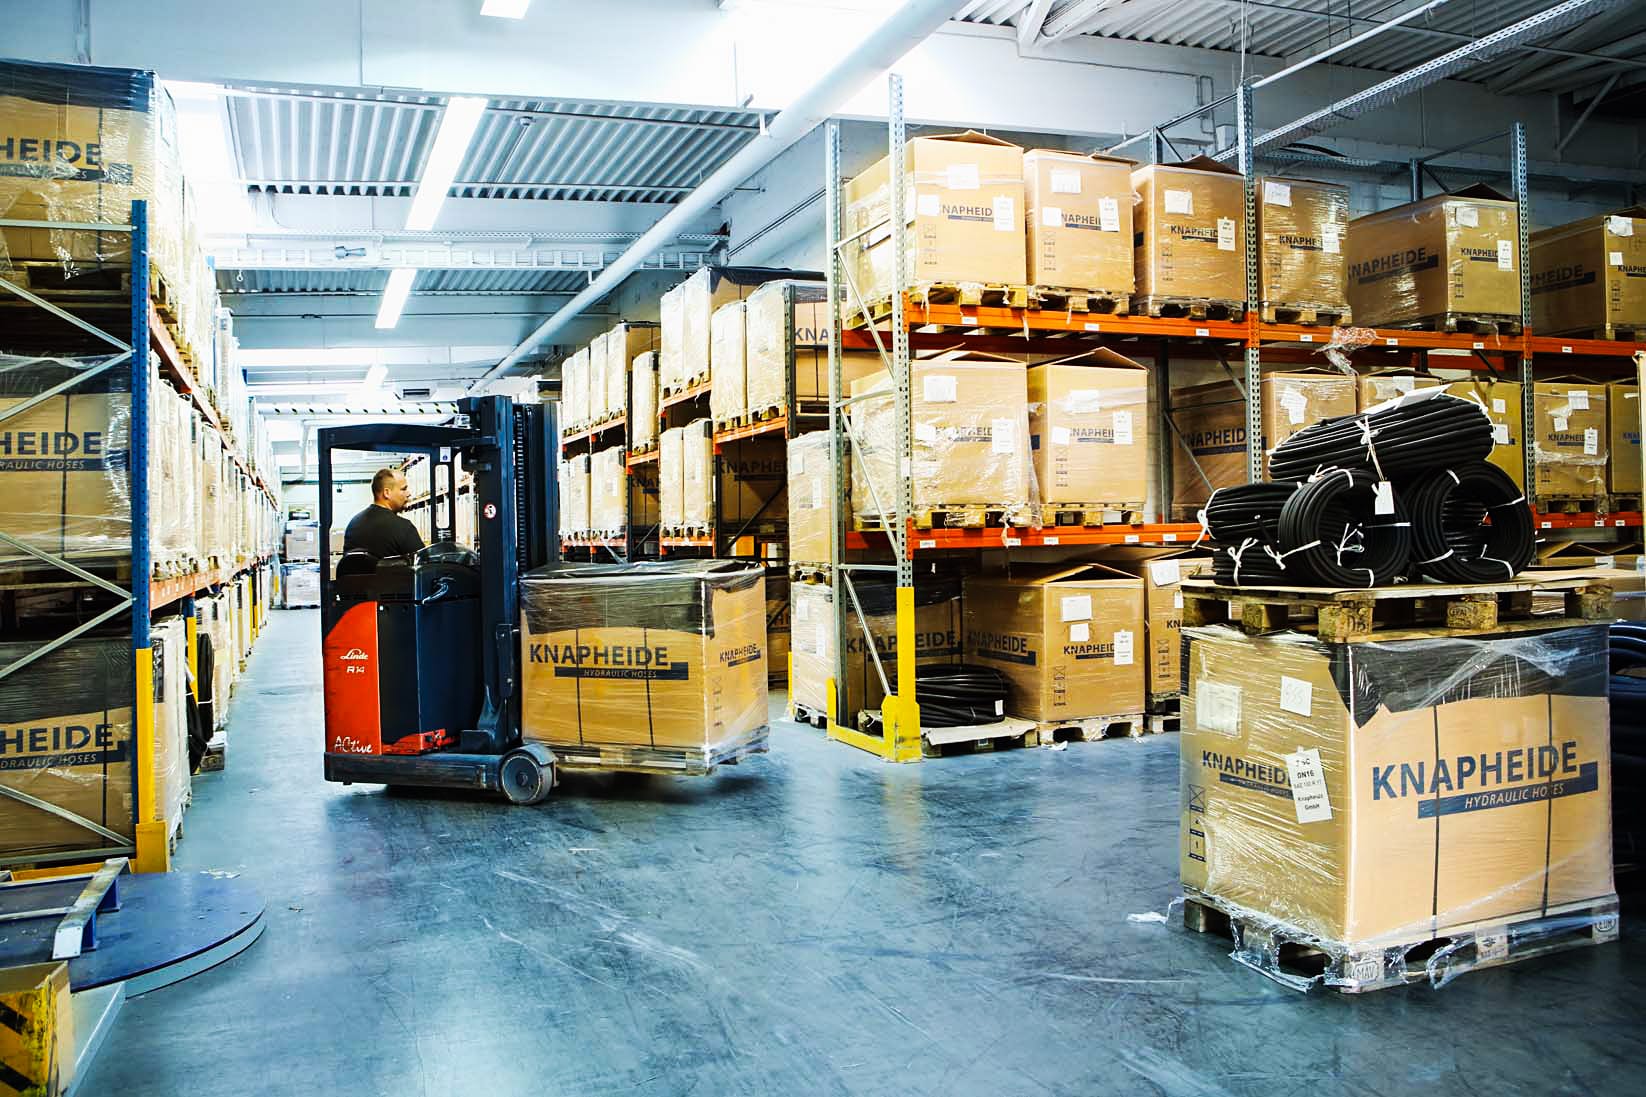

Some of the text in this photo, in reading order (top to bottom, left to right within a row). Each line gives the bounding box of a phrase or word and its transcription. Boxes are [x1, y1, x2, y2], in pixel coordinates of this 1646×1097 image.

[1061, 212, 1101, 225] NAPHEI
[47, 460, 85, 470] HOSES
[846, 630, 956, 653] KNAPEIDE
[340, 648, 369, 660] Linde
[529, 643, 669, 667] KNAPHEIDE
[584, 669, 630, 678] HYDRAULIC
[0, 724, 114, 755] HEIDE
[59, 753, 97, 765] HOSES
[1202, 750, 1291, 787] KNAPHEID
[1372, 741, 1577, 801] KNAPHEIDE
[1465, 783, 1565, 809] HYDRAULIC HOES
